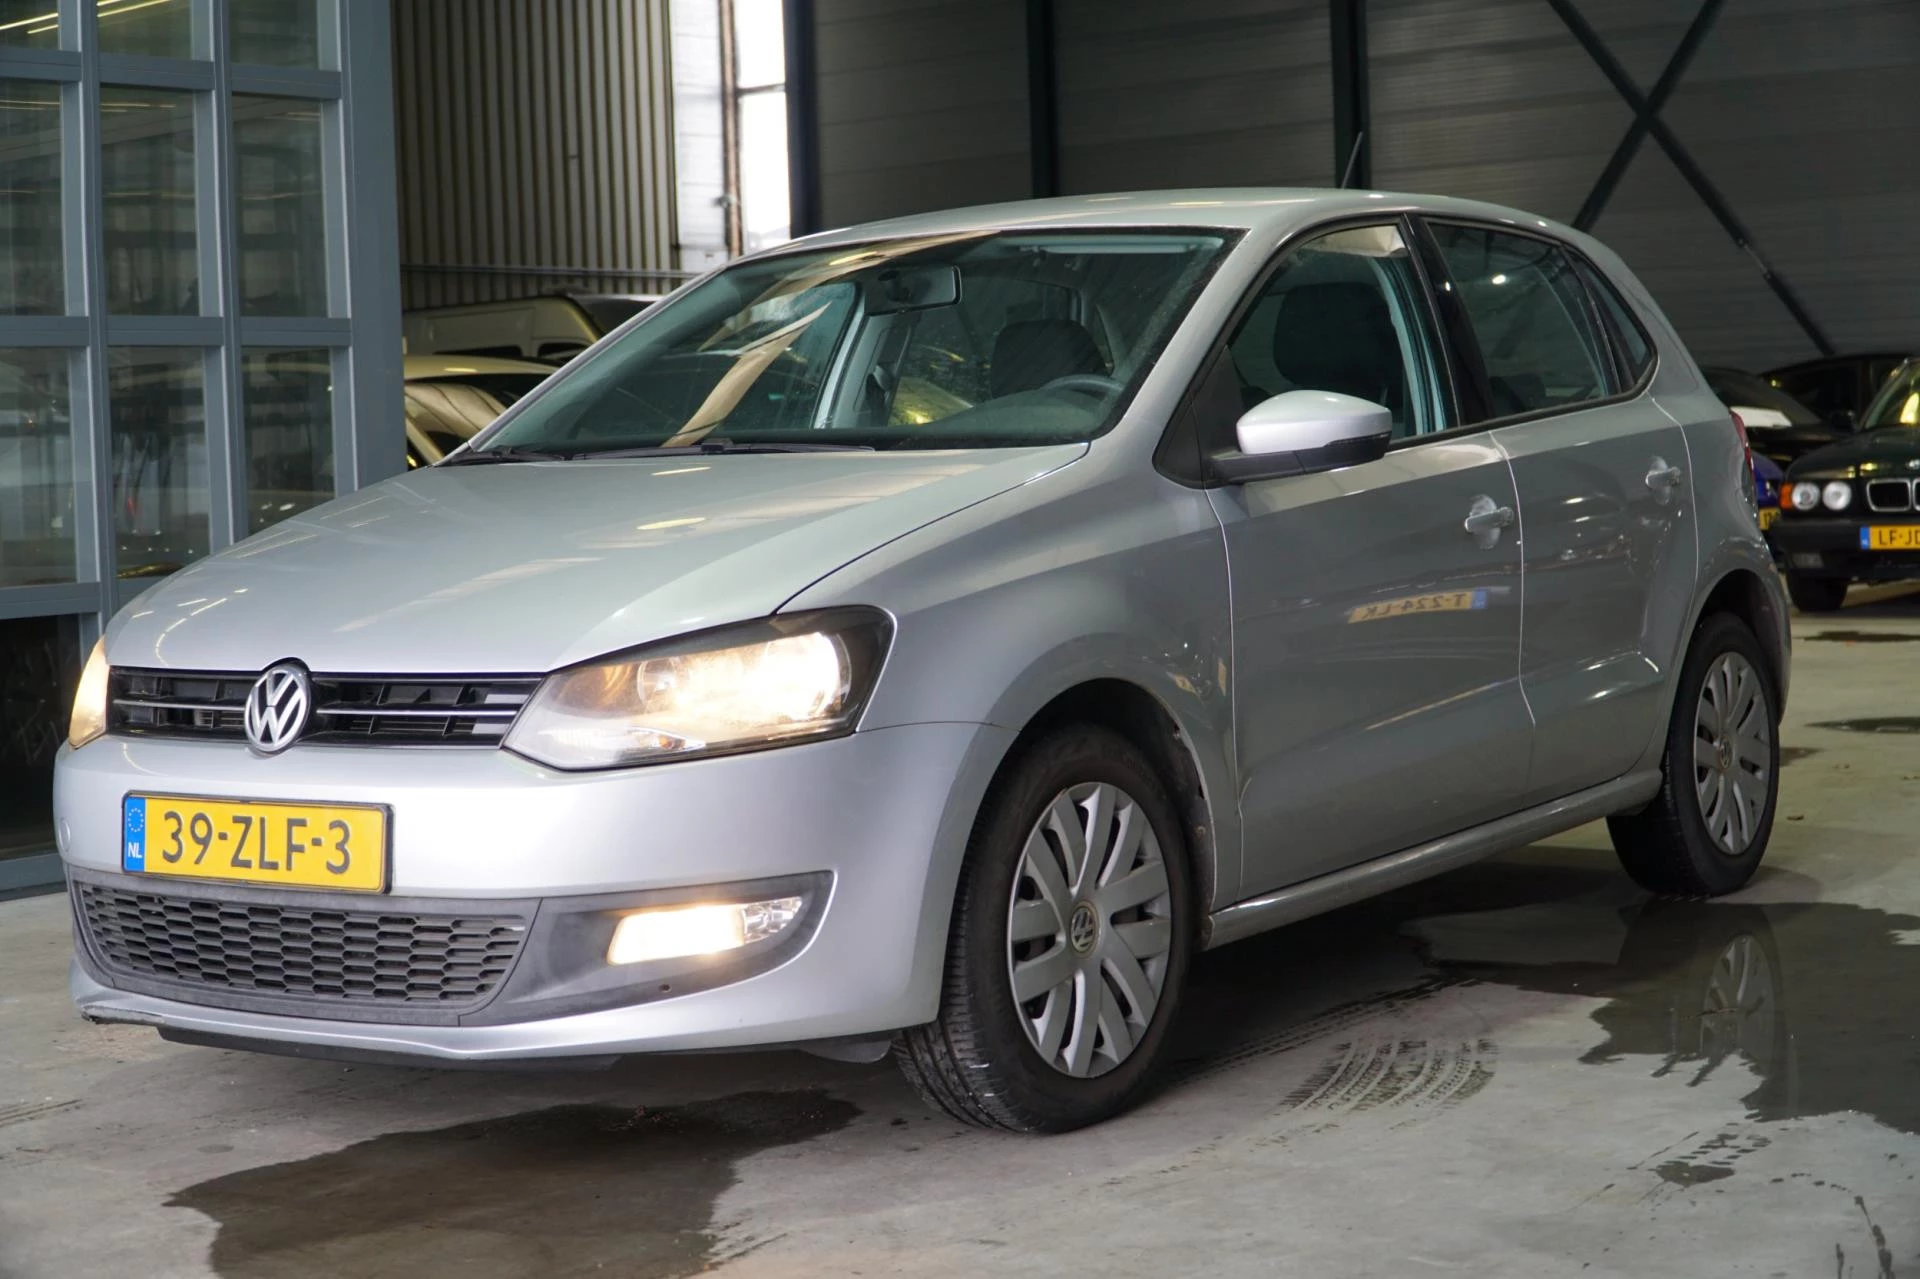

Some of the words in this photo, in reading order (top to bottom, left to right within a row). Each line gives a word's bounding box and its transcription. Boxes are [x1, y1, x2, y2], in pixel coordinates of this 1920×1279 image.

[244, 665, 310, 752] VW
[127, 842, 142, 859] NL
[162, 811, 351, 875] 39-ZLF-3
